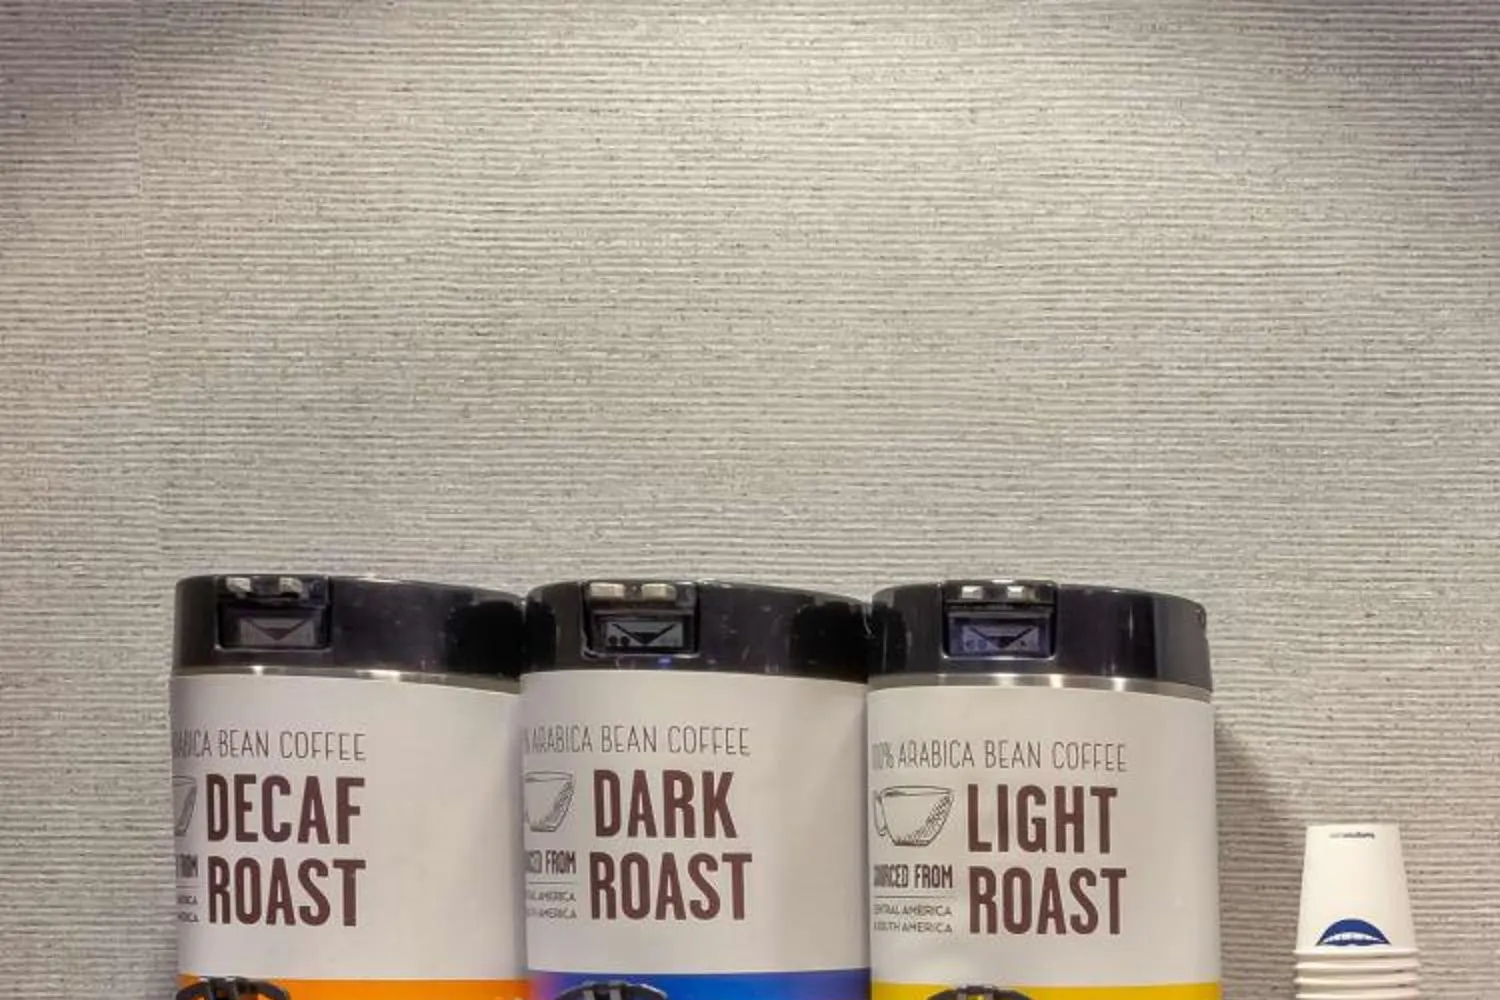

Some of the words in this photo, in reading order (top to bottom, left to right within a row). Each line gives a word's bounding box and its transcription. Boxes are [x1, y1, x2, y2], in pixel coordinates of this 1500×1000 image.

[219, 729, 269, 758] BEAN
[279, 731, 366, 762] COFFEE
[600, 725, 657, 753] BEAN
[667, 725, 751, 756] COFFEE
[899, 739, 976, 769] ARABICA
[985, 739, 1042, 769] BEAN
[1052, 741, 1128, 772] COFFEE
[206, 774, 366, 844] DECAF
[593, 769, 737, 839] DARK
[967, 783, 1118, 853] LIGHT
[207, 855, 367, 926] ROAST
[590, 852, 753, 920] ROAST
[914, 864, 953, 889] FROM
[968, 866, 1127, 935] ROAST
[902, 921, 953, 933] AMERICA
